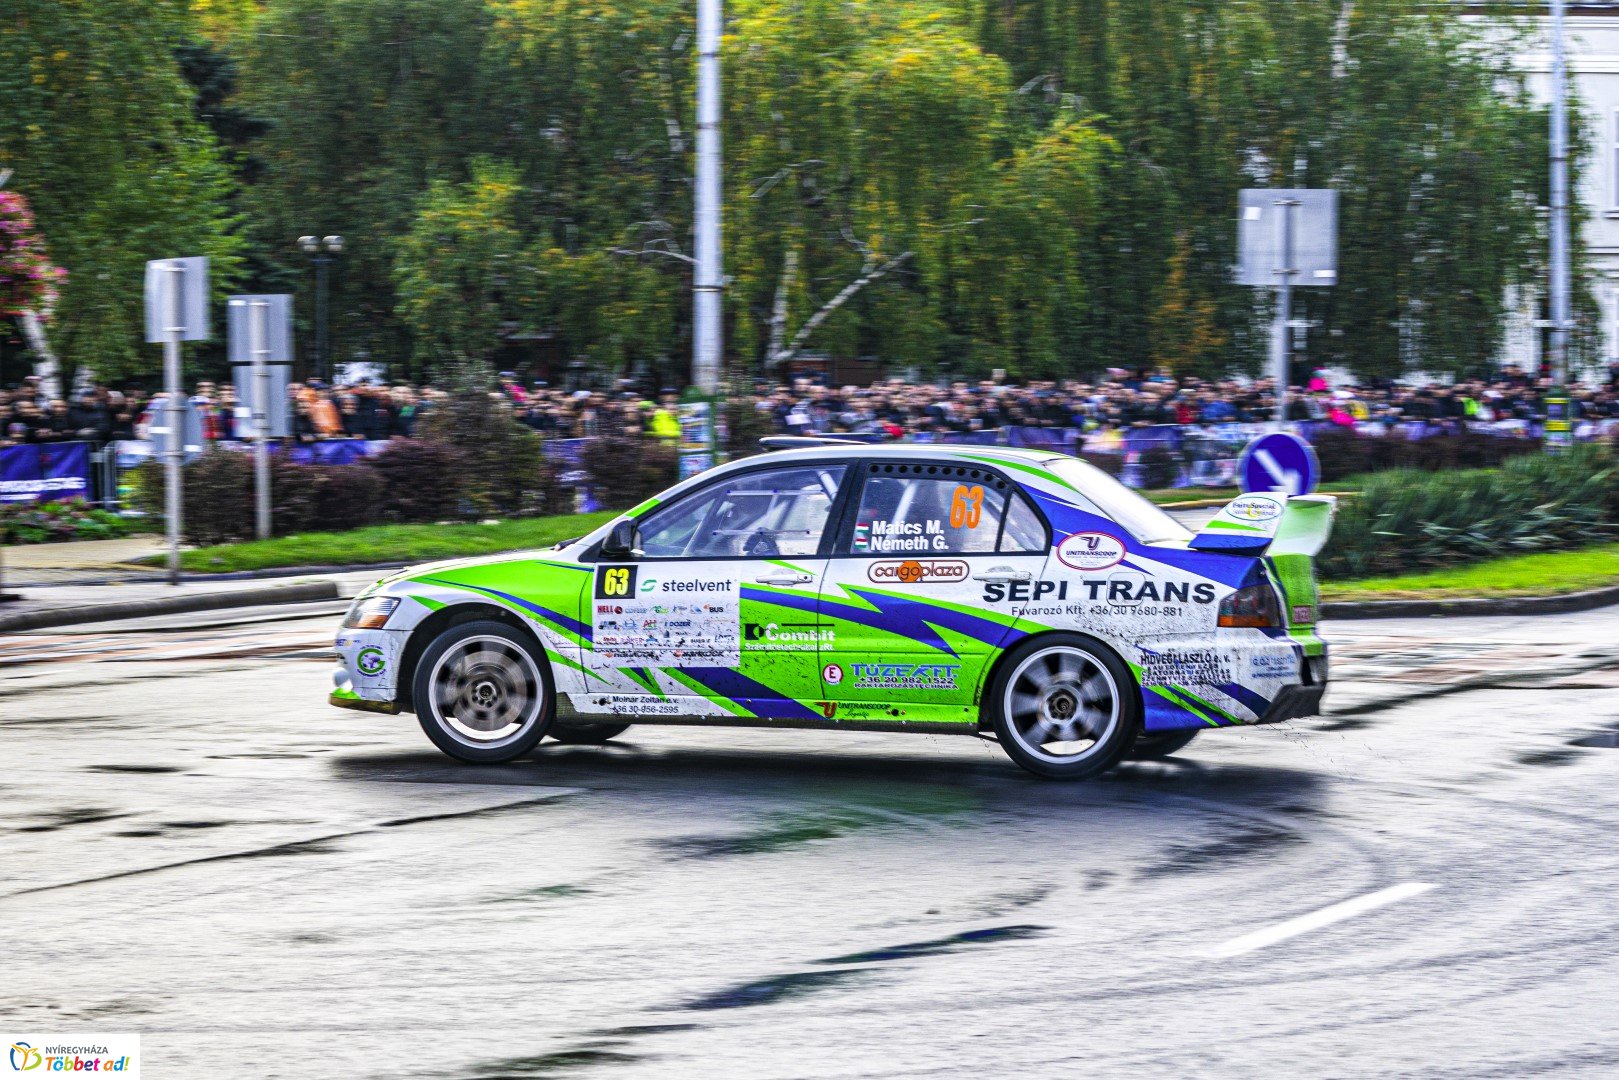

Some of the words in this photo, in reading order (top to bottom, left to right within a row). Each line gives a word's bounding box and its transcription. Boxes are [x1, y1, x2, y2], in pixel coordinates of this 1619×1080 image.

[949, 485, 984, 529] 63
[871, 520, 923, 535] Matics
[925, 519, 945, 535] M.
[932, 535, 950, 550] G.
[874, 561, 963, 582] cargoplaza
[604, 568, 630, 596] 63
[662, 578, 732, 592] steelvent
[982, 580, 1068, 603] SEPI
[1082, 580, 1216, 604] TRANS
[1011, 605, 1062, 617] Fuvarozó
[1065, 605, 1086, 615] Kft.
[1089, 605, 1127, 616] +36/30
[1130, 606, 1183, 617] 9680-881
[765, 622, 836, 642] Combit
[828, 667, 838, 679] E
[901, 676, 923, 684] 982
[927, 676, 954, 684] 1522
